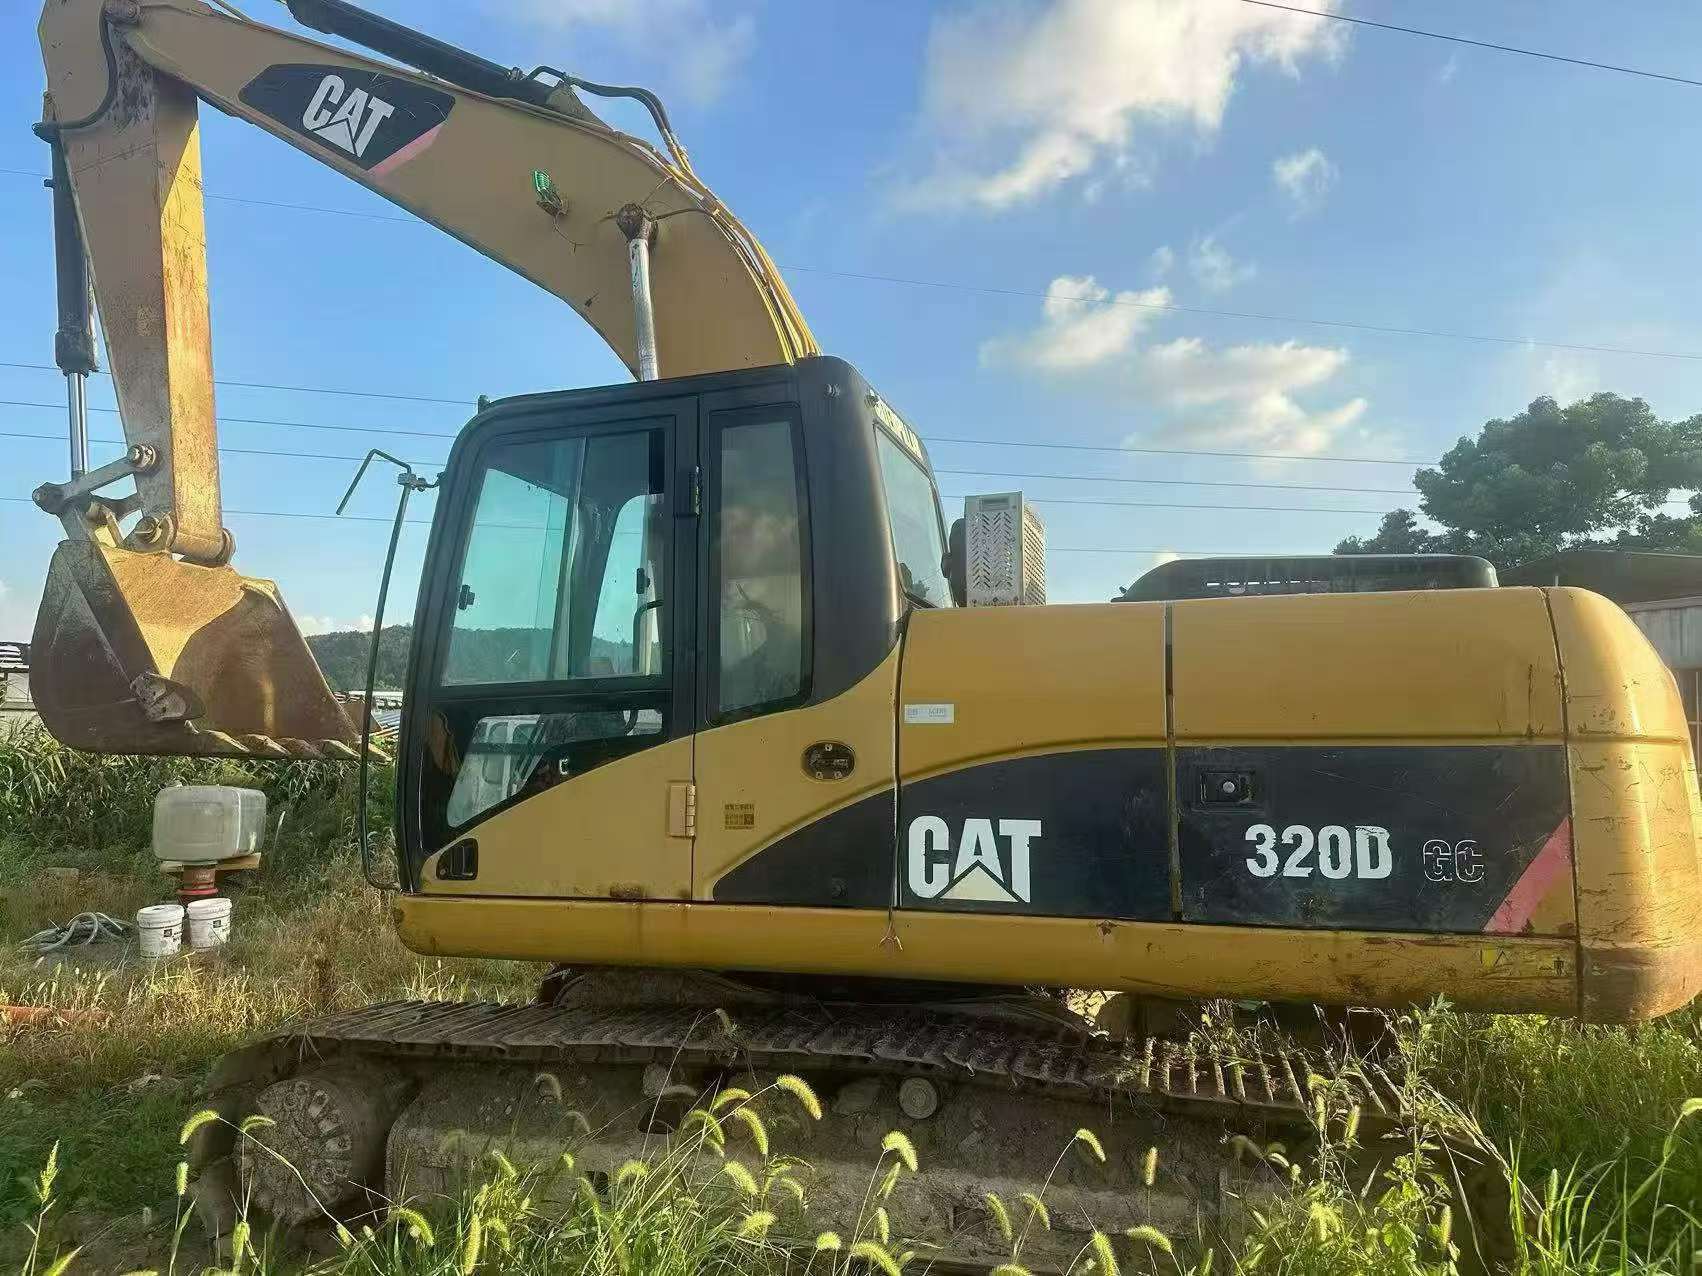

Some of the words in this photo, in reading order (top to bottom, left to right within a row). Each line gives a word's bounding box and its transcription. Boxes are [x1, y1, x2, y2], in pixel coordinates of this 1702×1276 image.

[303, 75, 395, 157] CAT
[908, 816, 1042, 903] CAT
[1245, 824, 1393, 879] 320D
[1422, 839, 1485, 882] GC
